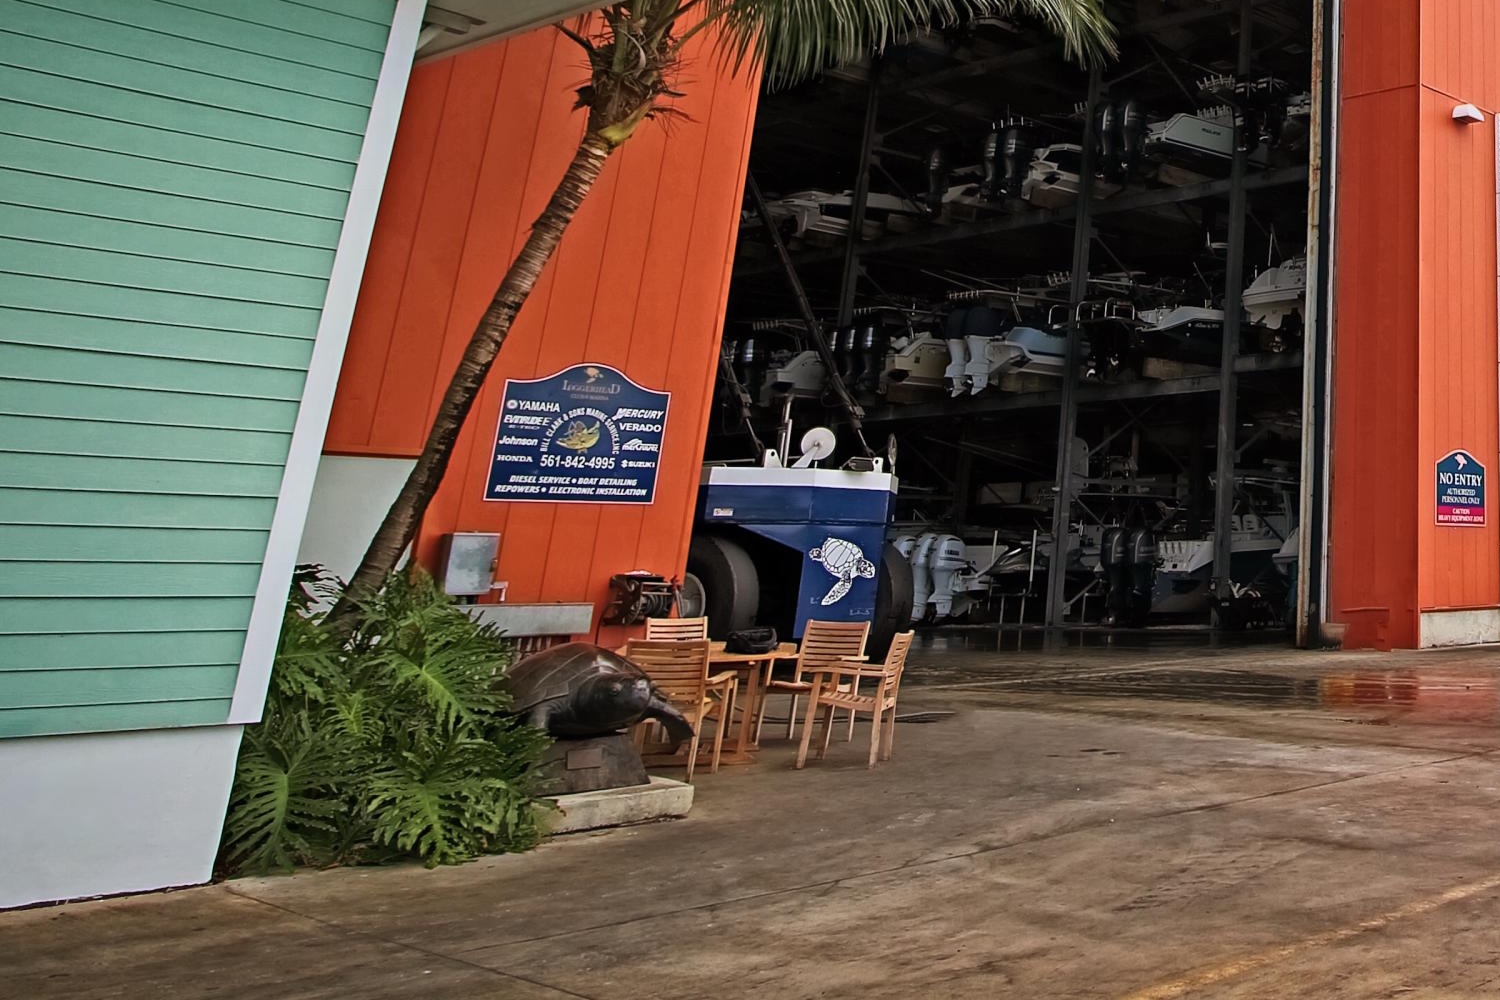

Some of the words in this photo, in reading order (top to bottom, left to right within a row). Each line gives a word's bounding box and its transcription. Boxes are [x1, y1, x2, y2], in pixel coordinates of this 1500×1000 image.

[519, 400, 560, 412] YAMAHA
[611, 408, 664, 420] MERCURY
[540, 438, 551, 452] BILL
[546, 417, 564, 437] CLARK
[568, 407, 585, 418] SONS
[586, 408, 608, 422] MARINE
[619, 422, 662, 432] VERADO
[499, 436, 538, 446] Johnson
[540, 454, 616, 469] 561-842-4995
[509, 475, 537, 484] DIESEL
[538, 476, 570, 484] SERVICE
[577, 477, 598, 485] BOAT
[598, 478, 637, 486] DETAILING
[1440, 472, 1453, 484] NO
[1454, 473, 1482, 486] ENTRY
[494, 485, 540, 493] REPOWERS
[548, 486, 596, 495] ELECTRONIC
[596, 487, 647, 496] INSTALLATION
